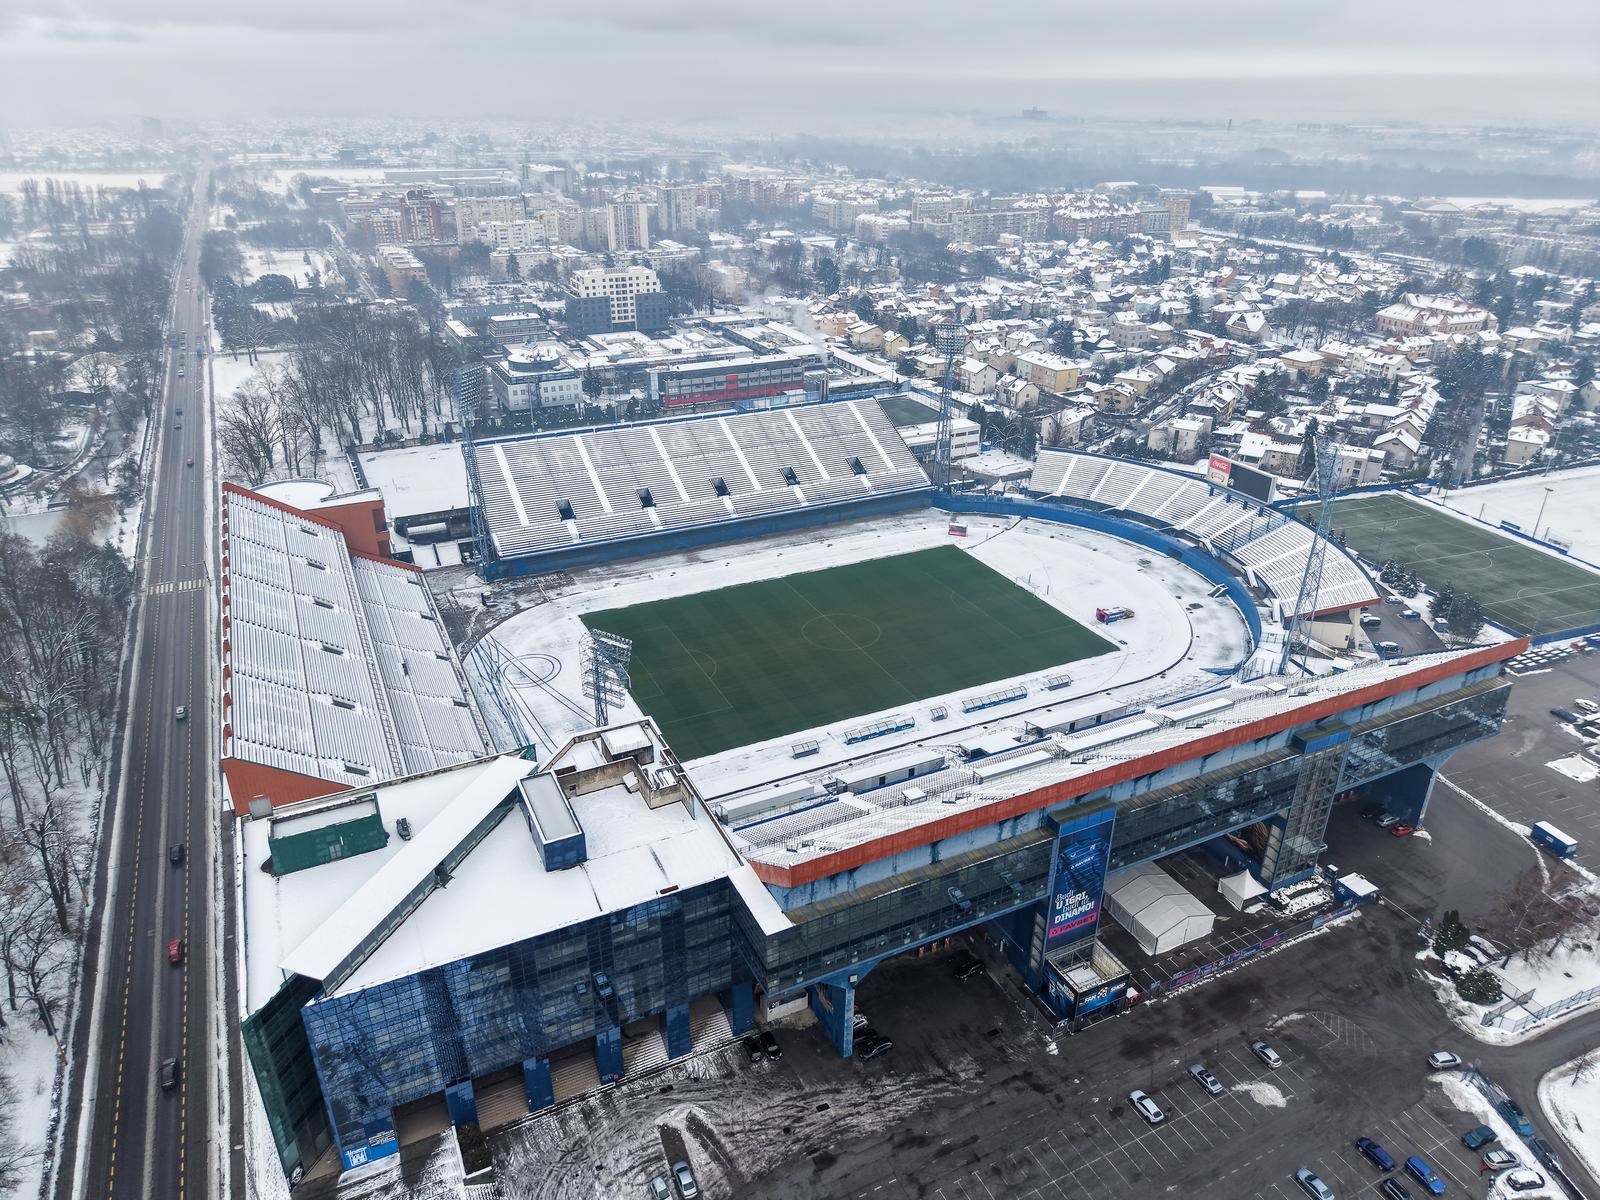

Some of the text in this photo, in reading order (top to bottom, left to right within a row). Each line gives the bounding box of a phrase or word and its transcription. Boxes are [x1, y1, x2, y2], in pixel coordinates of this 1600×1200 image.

[1055, 889, 1074, 903] Budi
[1056, 891, 1089, 910] U IGRI,
[1054, 901, 1095, 924] DINAMO!
[1059, 915, 1095, 931] FAVBET
[1084, 982, 1126, 1003] FAN SHOP
